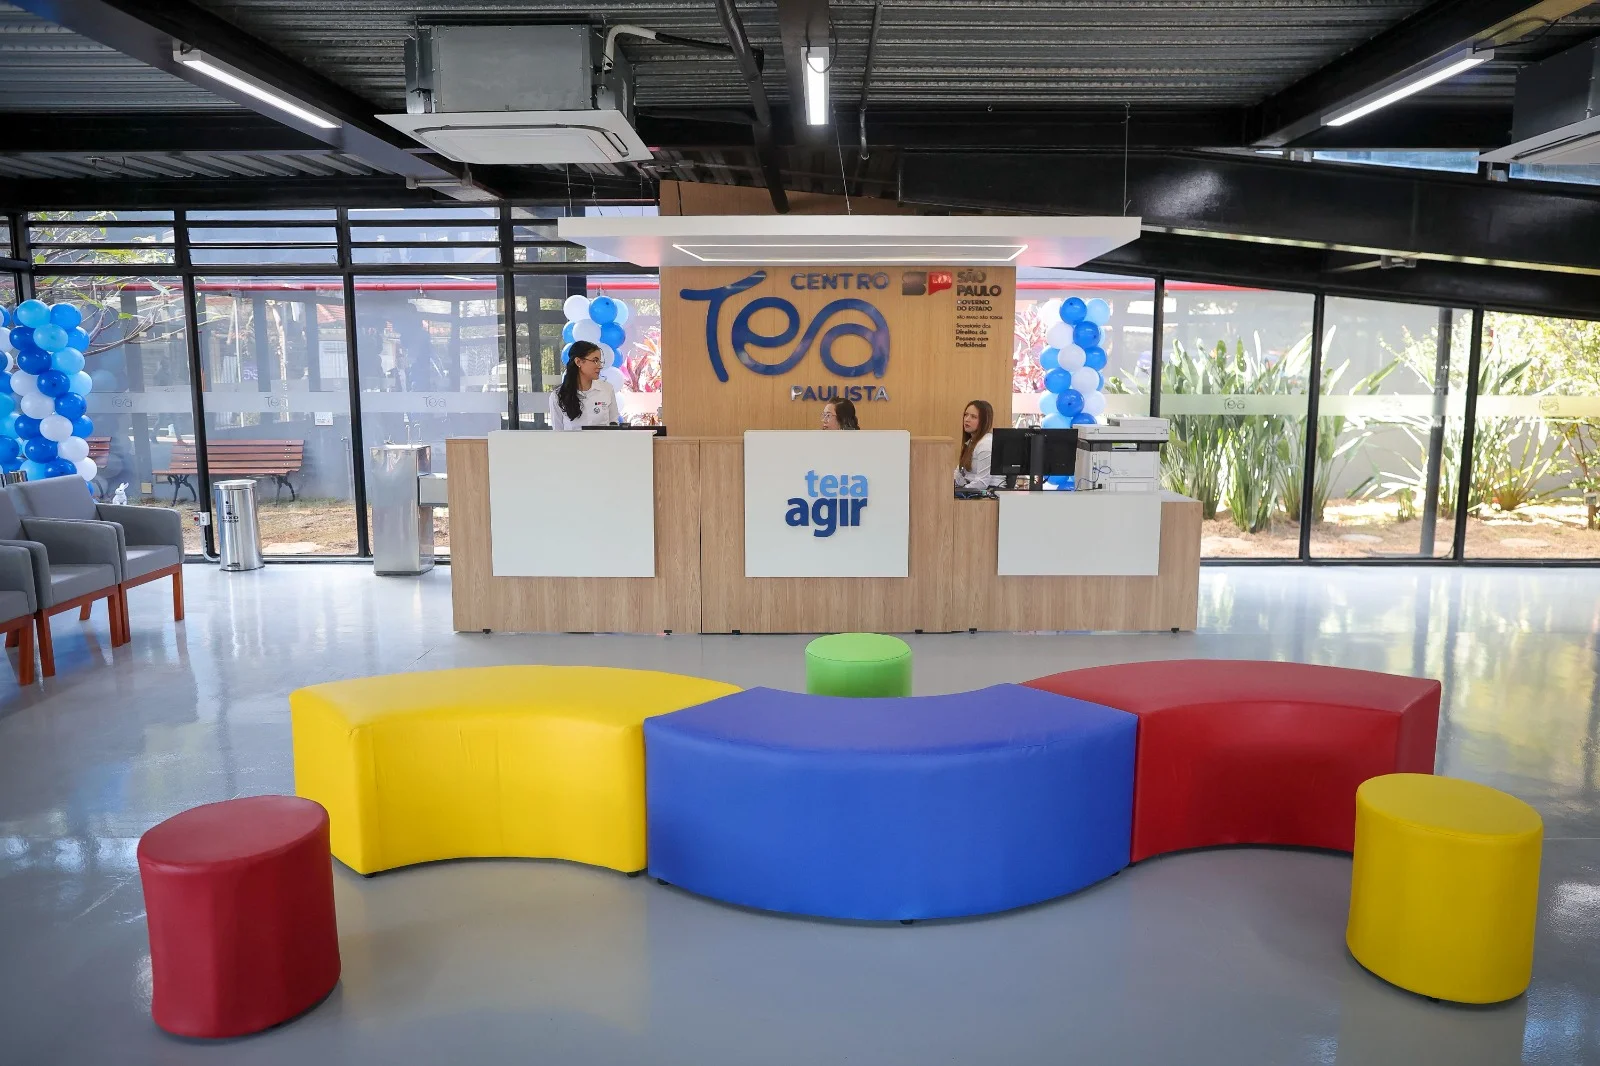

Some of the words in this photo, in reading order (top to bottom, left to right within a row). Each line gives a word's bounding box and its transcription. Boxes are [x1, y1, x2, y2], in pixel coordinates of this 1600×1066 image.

[790, 272, 890, 290] CENTRO
[957, 269, 987, 283] SÃO
[956, 285, 1002, 297] PAULO
[790, 386, 889, 401] PAULISTA
[785, 498, 868, 538] agir
